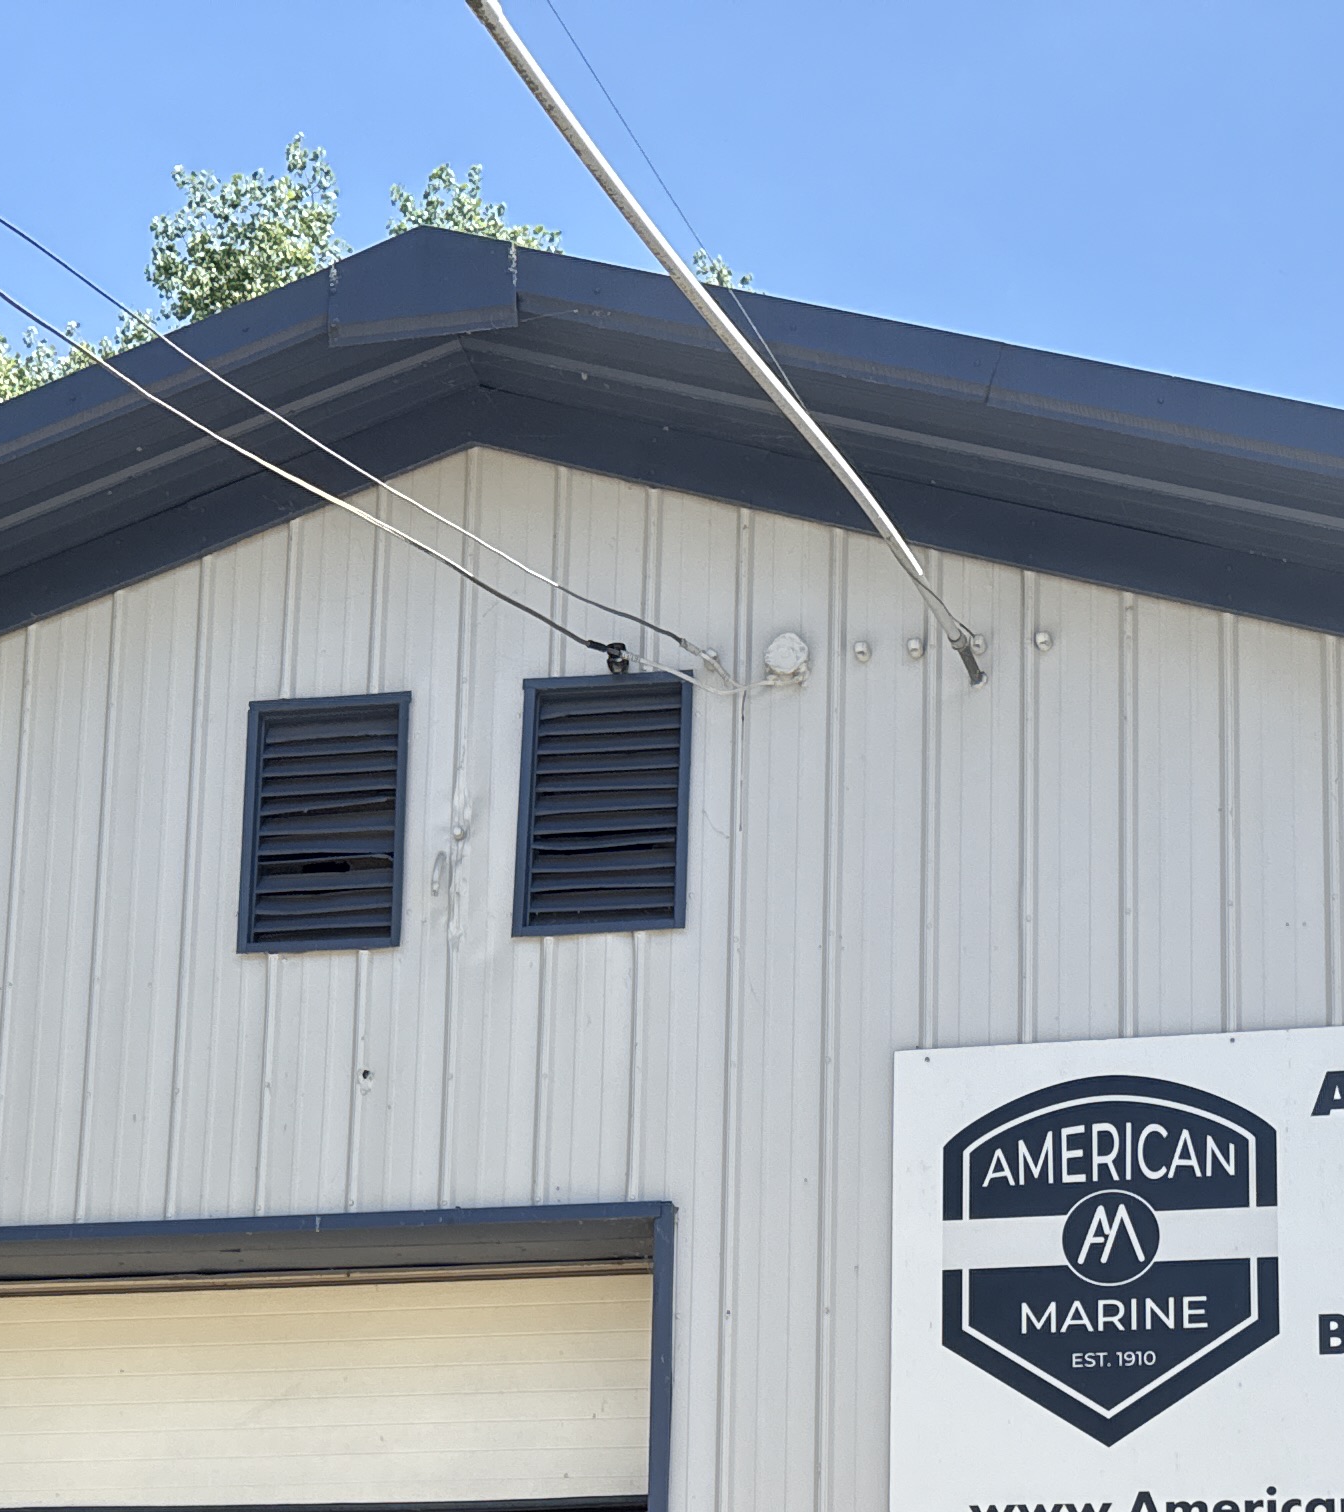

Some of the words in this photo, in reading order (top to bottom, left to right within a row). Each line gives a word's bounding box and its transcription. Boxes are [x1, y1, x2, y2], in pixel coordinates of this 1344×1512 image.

[982, 1122, 1236, 1188] AMERICAN
[1021, 1295, 1209, 1334] MARINE
[1072, 1352, 1113, 1368] EST.
[1115, 1351, 1157, 1367] 1910
